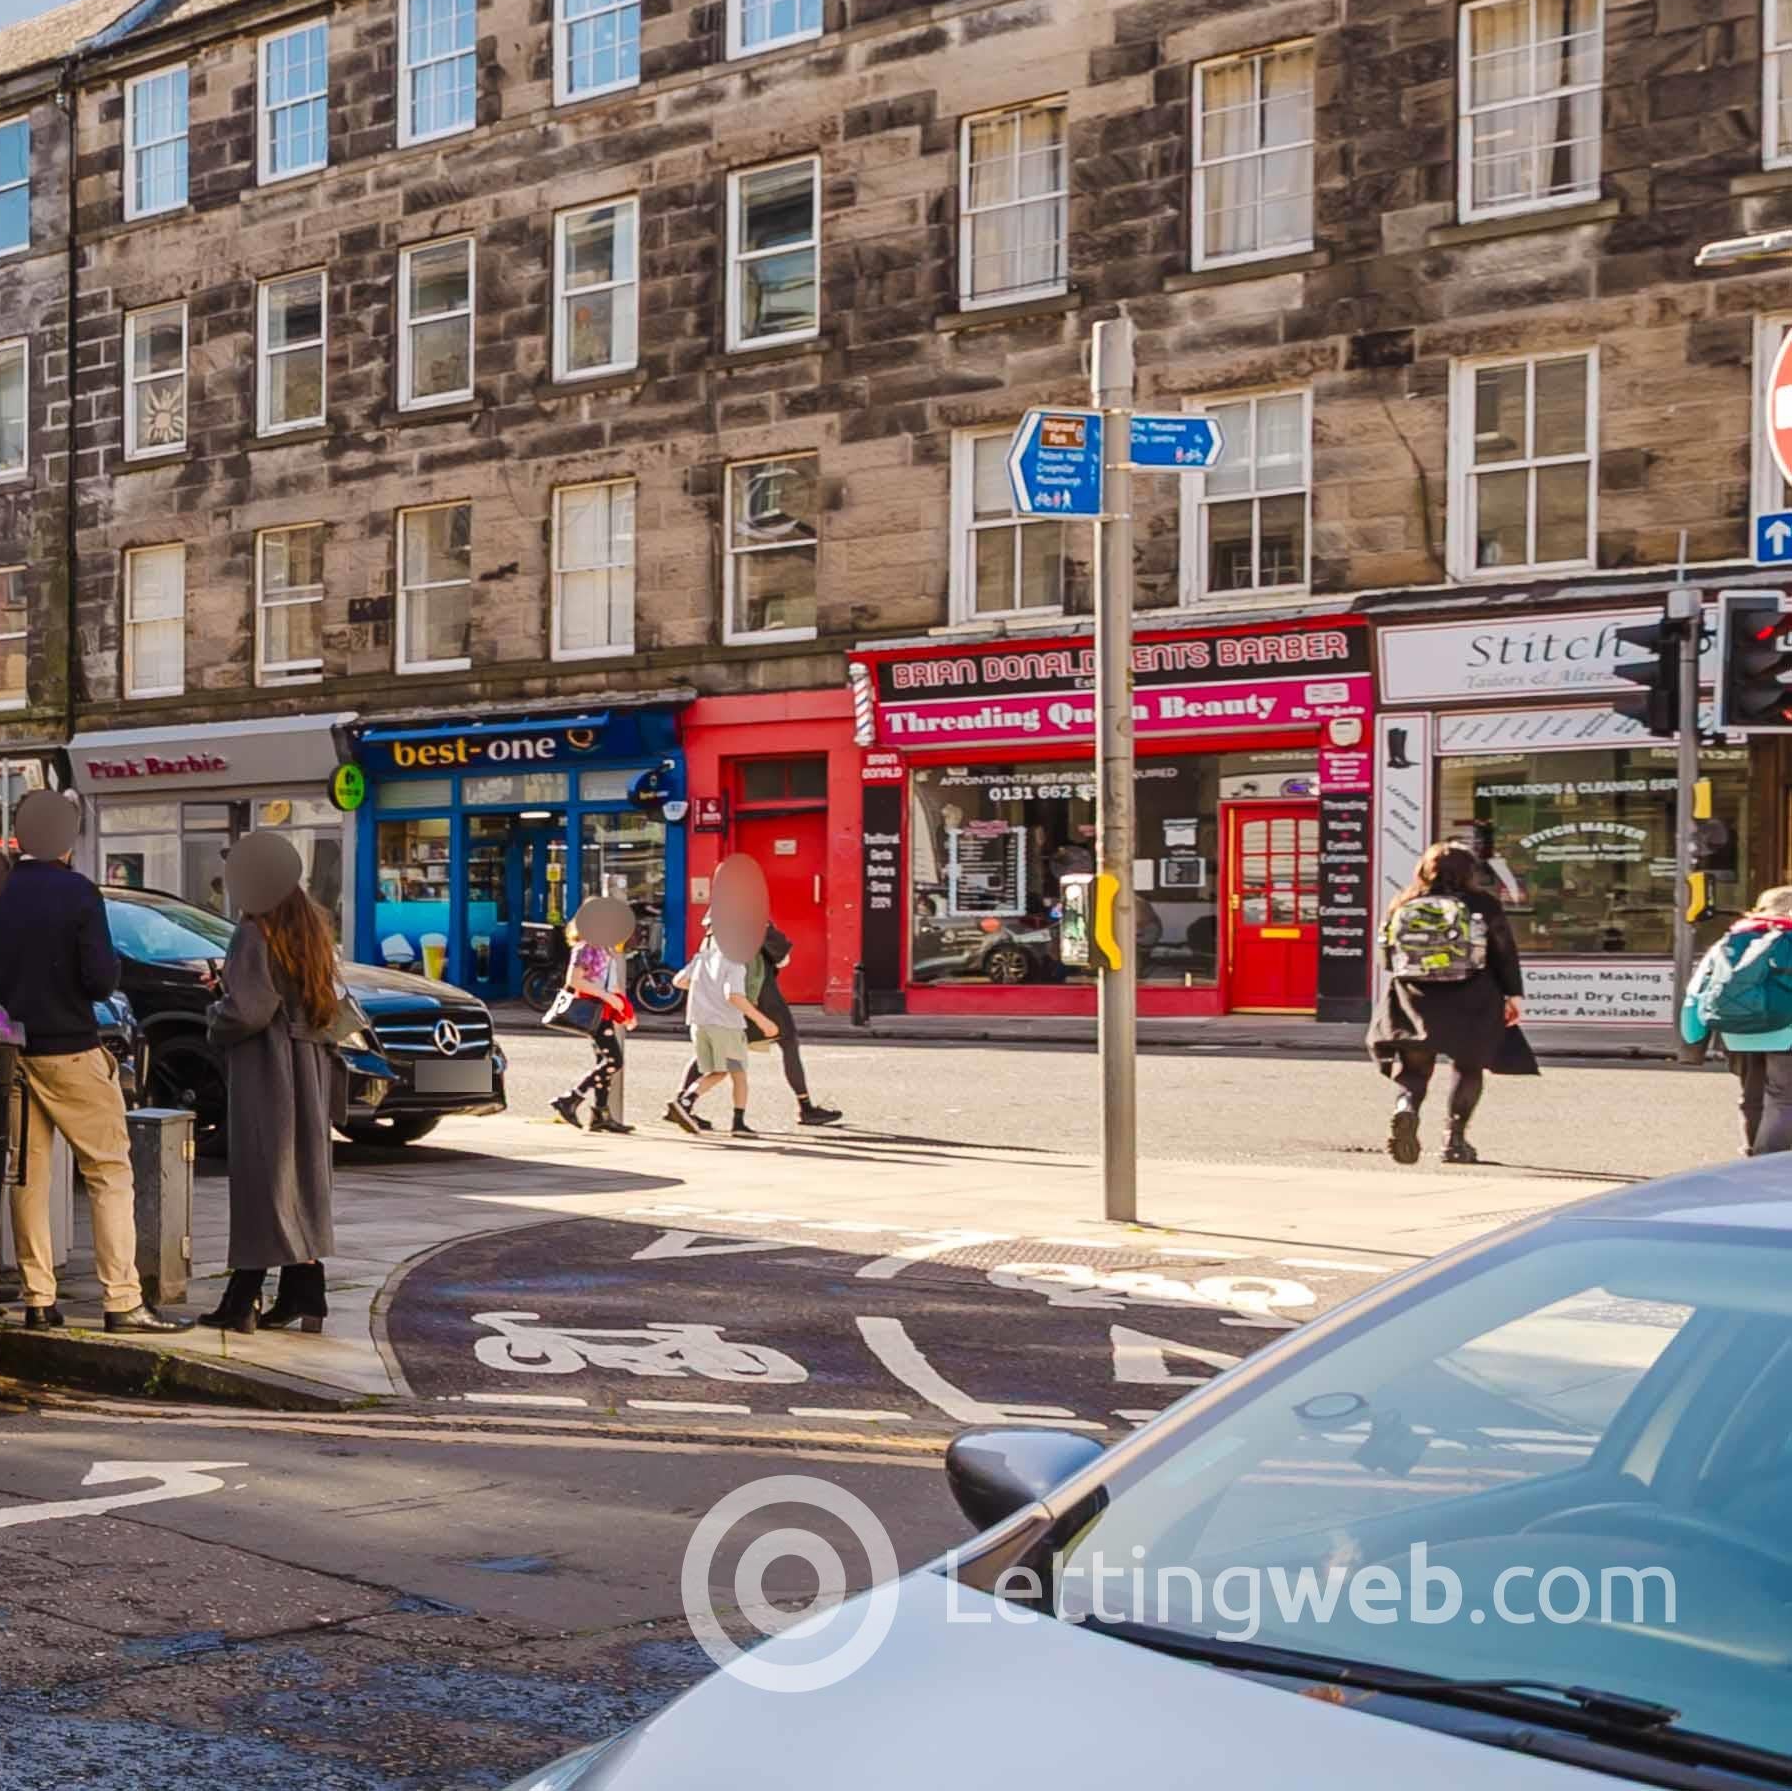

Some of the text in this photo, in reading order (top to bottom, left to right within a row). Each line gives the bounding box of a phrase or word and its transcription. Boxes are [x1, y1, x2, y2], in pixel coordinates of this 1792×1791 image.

[1466, 621, 1626, 668] Stitch
[892, 631, 1350, 690] BRIAN DONALD ENTS BARBER
[886, 706, 1041, 733] Threading
[1047, 694, 1150, 730] Qun
[1158, 694, 1278, 720] Beauty
[86, 751, 229, 779] Pink Barbie
[988, 786, 1034, 802] 0131
[1036, 785, 1072, 800] 662
[1475, 781, 1563, 797] ALTERATIONS
[1577, 779, 1646, 794] CLEANING
[1520, 821, 1648, 849] STITCH MASTER
[1526, 970, 1594, 982] Cushion
[1599, 971, 1662, 984] Making
[1584, 991, 1615, 1004] Dry
[1620, 991, 1673, 1002] Clean
[1524, 1007, 1657, 1018] rvice Available
